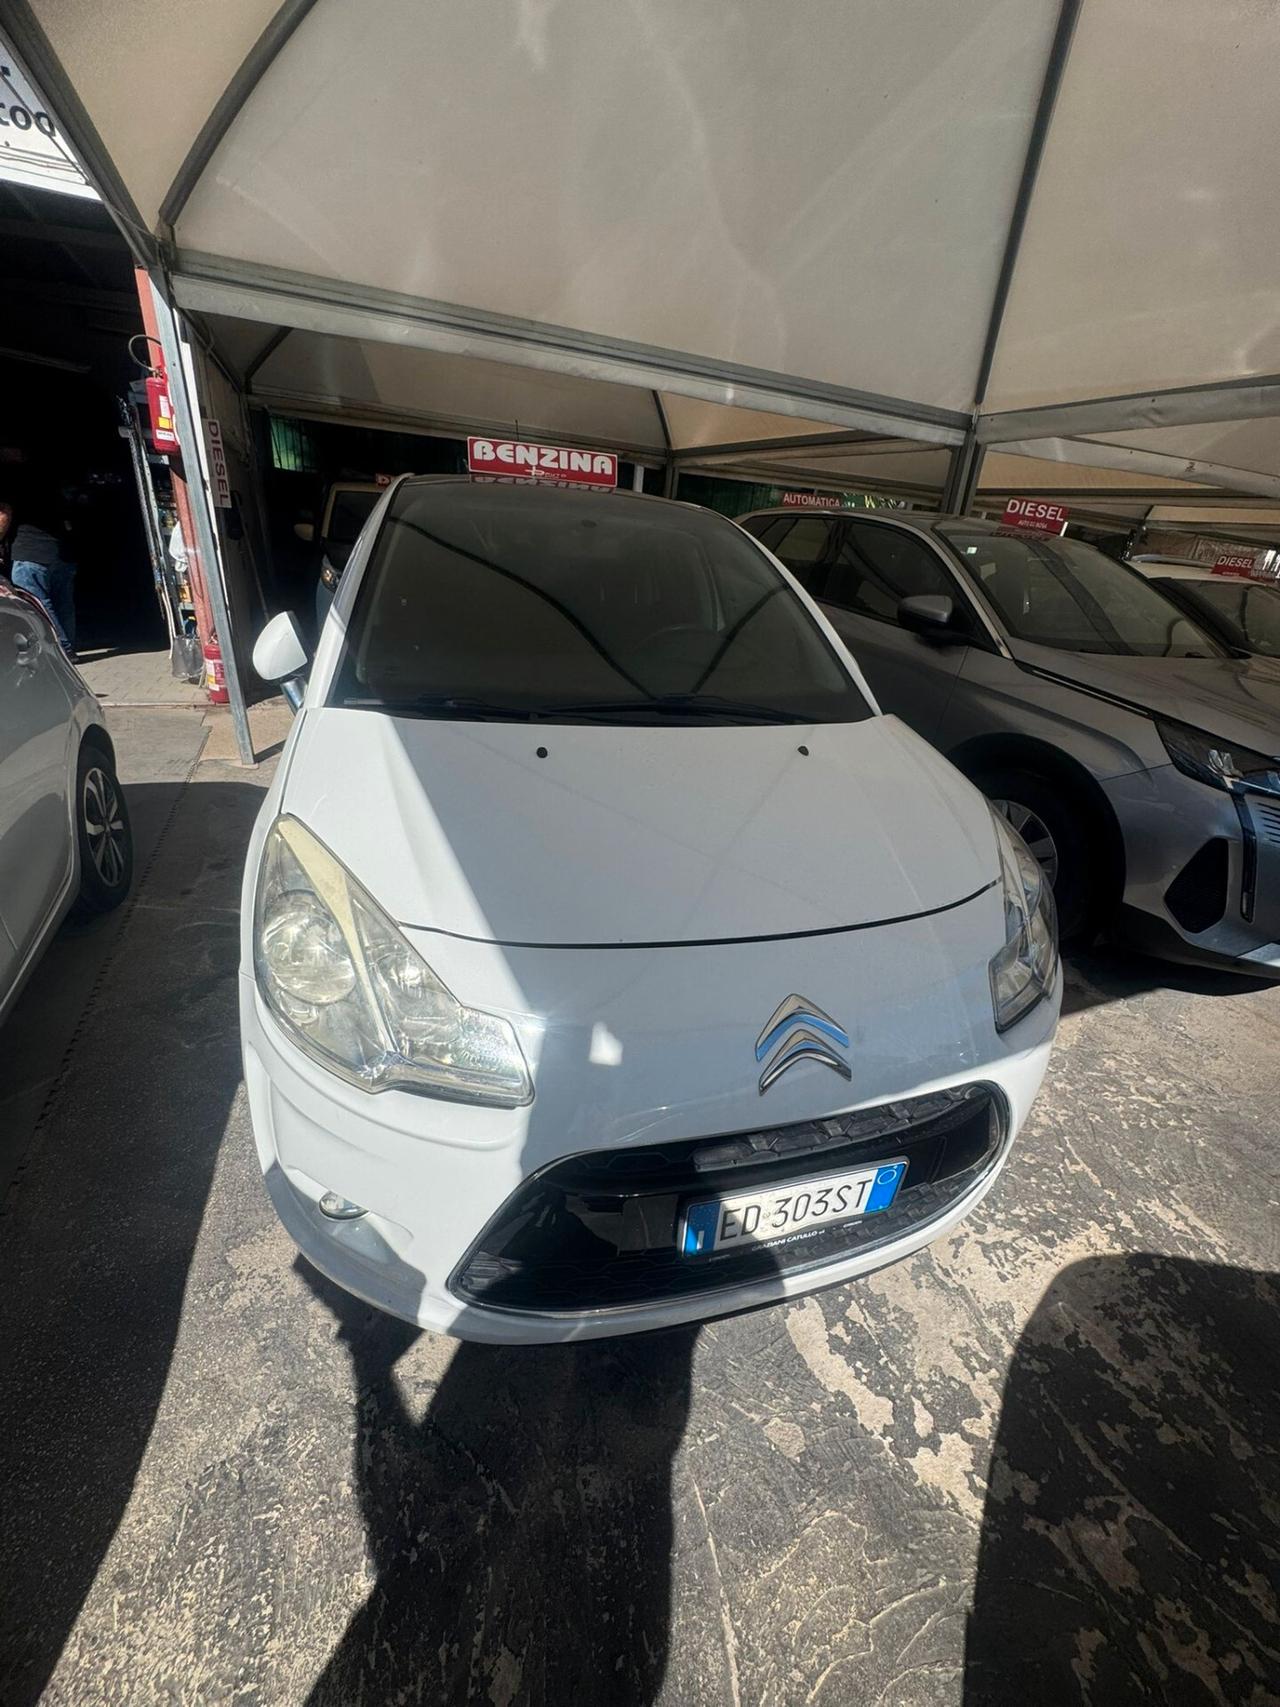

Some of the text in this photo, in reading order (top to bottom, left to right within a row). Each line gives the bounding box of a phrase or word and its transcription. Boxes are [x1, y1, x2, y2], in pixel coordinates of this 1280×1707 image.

[208, 421, 229, 506] DIESEL
[473, 440, 613, 475] BENZINA
[783, 493, 840, 507] AUTOMATICA
[1006, 499, 1064, 521] DIESEL
[1217, 556, 1253, 569] DIESEL
